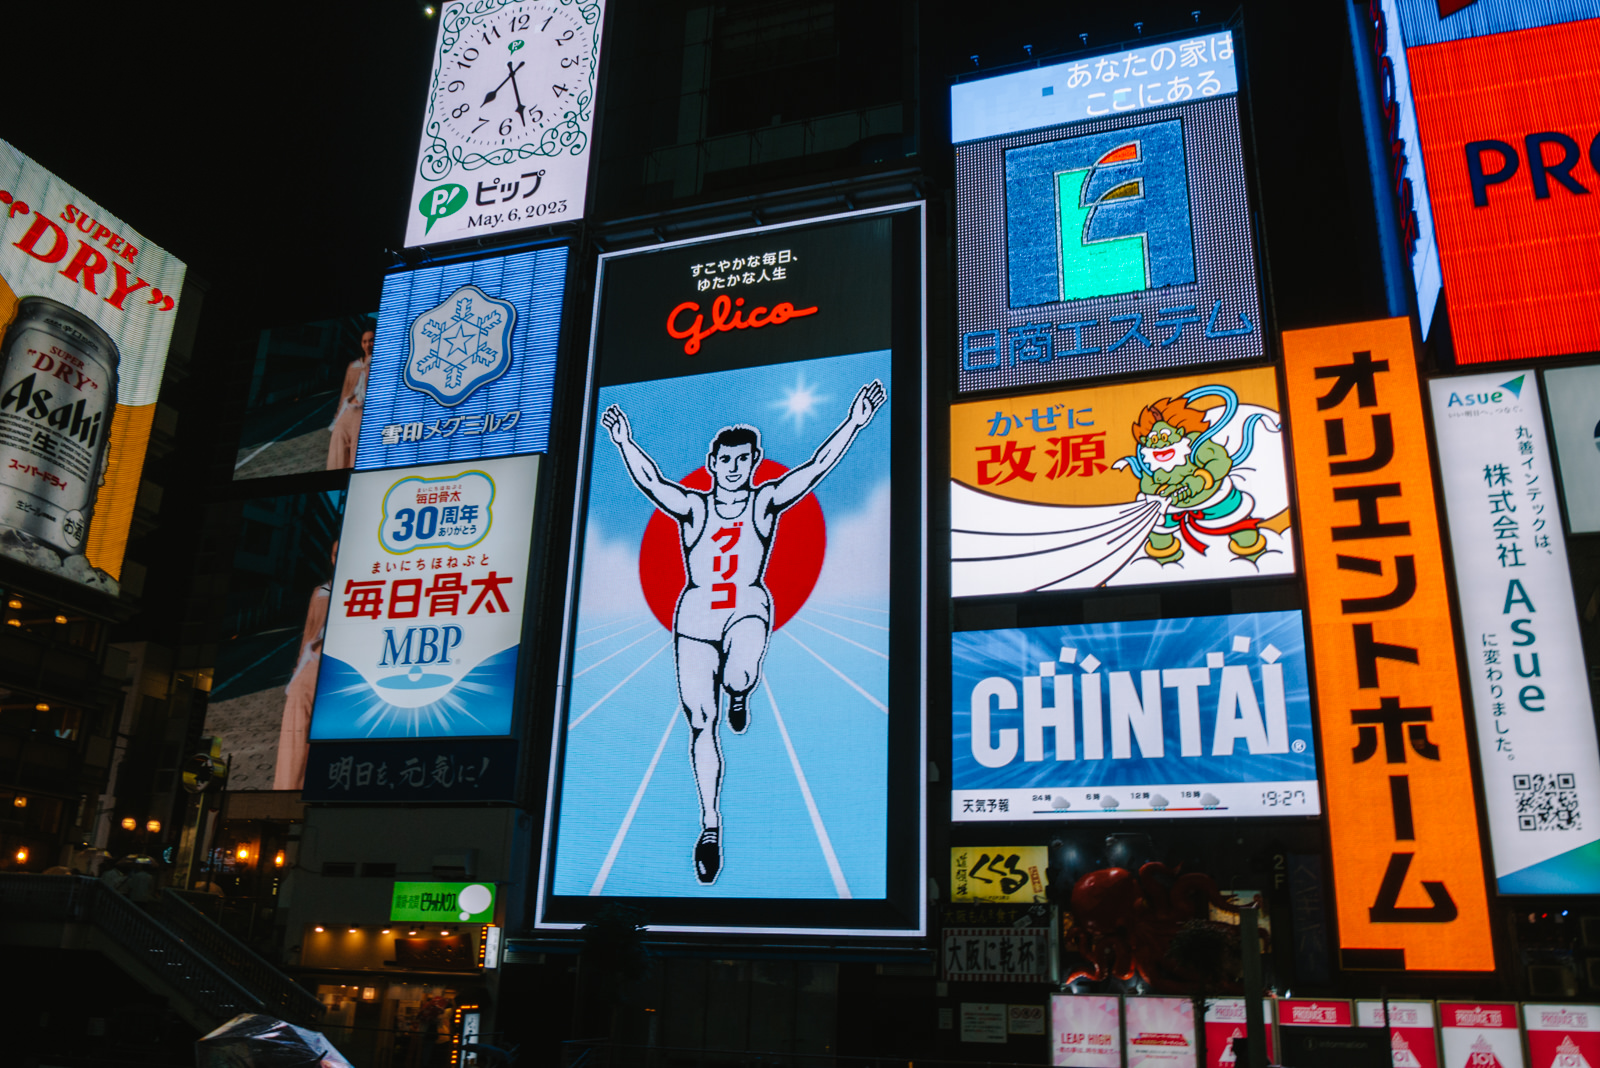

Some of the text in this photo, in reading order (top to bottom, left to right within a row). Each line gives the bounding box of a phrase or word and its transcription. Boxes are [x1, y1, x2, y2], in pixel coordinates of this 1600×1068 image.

[481, 25, 501, 45] 11
[508, 14, 531, 32] 12
[541, 16, 554, 32] 1
[555, 29, 575, 46] 2
[457, 48, 479, 69] 10
[560, 55, 580, 69] 3
[1066, 34, 1235, 89] あなたの家は
[447, 80, 465, 93] 9
[551, 83, 569, 98] 4
[1085, 69, 1222, 117] ここにある
[451, 103, 470, 119] 8
[528, 104, 543, 123] 5
[471, 117, 490, 134] 7
[499, 118, 513, 136] 6
[1465, 131, 1600, 208] PR
[475, 169, 546, 206] ピップ
[467, 200, 568, 229] May. 6, 2023
[59, 204, 139, 264] SUPER
[690, 249, 799, 278] すこやかな毎日、
[697, 266, 788, 292] ゆたかな人生
[666, 294, 819, 356] Glico
[962, 299, 1254, 371] 日商エステム
[50, 346, 85, 370] SUPER
[1, 373, 101, 449] Asahi
[1447, 391, 1503, 408] Asue
[381, 410, 521, 446] 雪印メグミルク
[987, 403, 1096, 438] かぜに
[32, 431, 58, 457] 生
[975, 430, 1109, 487] 改源
[8, 459, 68, 491] スーパードライ
[416, 491, 462, 505] 毎日骨太
[1515, 425, 1552, 555] 丸善インテックは、
[438, 524, 477, 537] ありがとう
[371, 554, 490, 575] まいにちほねぶと
[711, 521, 744, 610] グリコ
[343, 571, 514, 620] 毎日骨太
[1483, 463, 1546, 713] 株式会社 Asue
[379, 624, 463, 667] MBP
[1314, 350, 1459, 924] オリエントホーム
[970, 635, 1290, 769] CHINTAI
[1483, 633, 1515, 761] に変わりました。
[962, 798, 1011, 814] 天気予報
[1261, 789, 1306, 808] 19:27
[969, 854, 1029, 894] くくる
[1061, 1033, 1085, 1044] LEAP
[1472, 1053, 1495, 1065] 101
